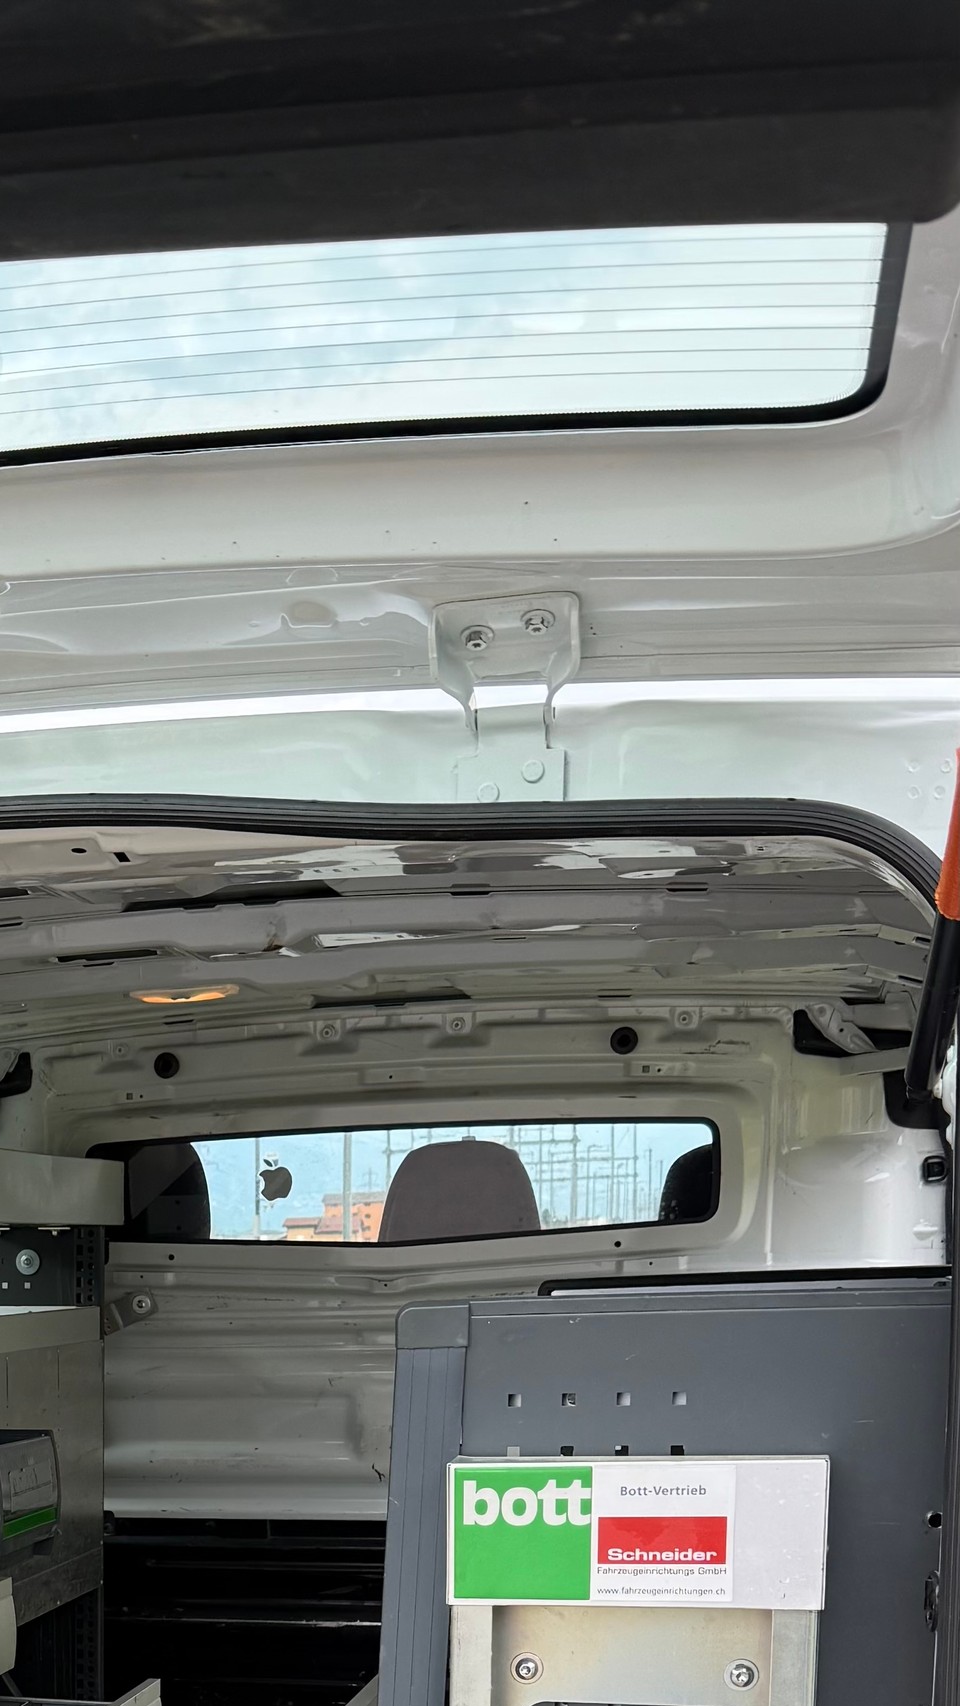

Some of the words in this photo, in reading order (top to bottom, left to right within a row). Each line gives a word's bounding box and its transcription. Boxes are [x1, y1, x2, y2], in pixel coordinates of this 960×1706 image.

[620, 1485, 707, 1496] Bott-Vertrieb
[463, 1479, 592, 1526] bott
[607, 1548, 718, 1561] Schneider
[597, 1567, 695, 1577] Fahrzeugeinrichtungs
[697, 1567, 727, 1576] GmbH
[597, 1587, 726, 1597] www.fahrzeugeinrichtungen.ch
